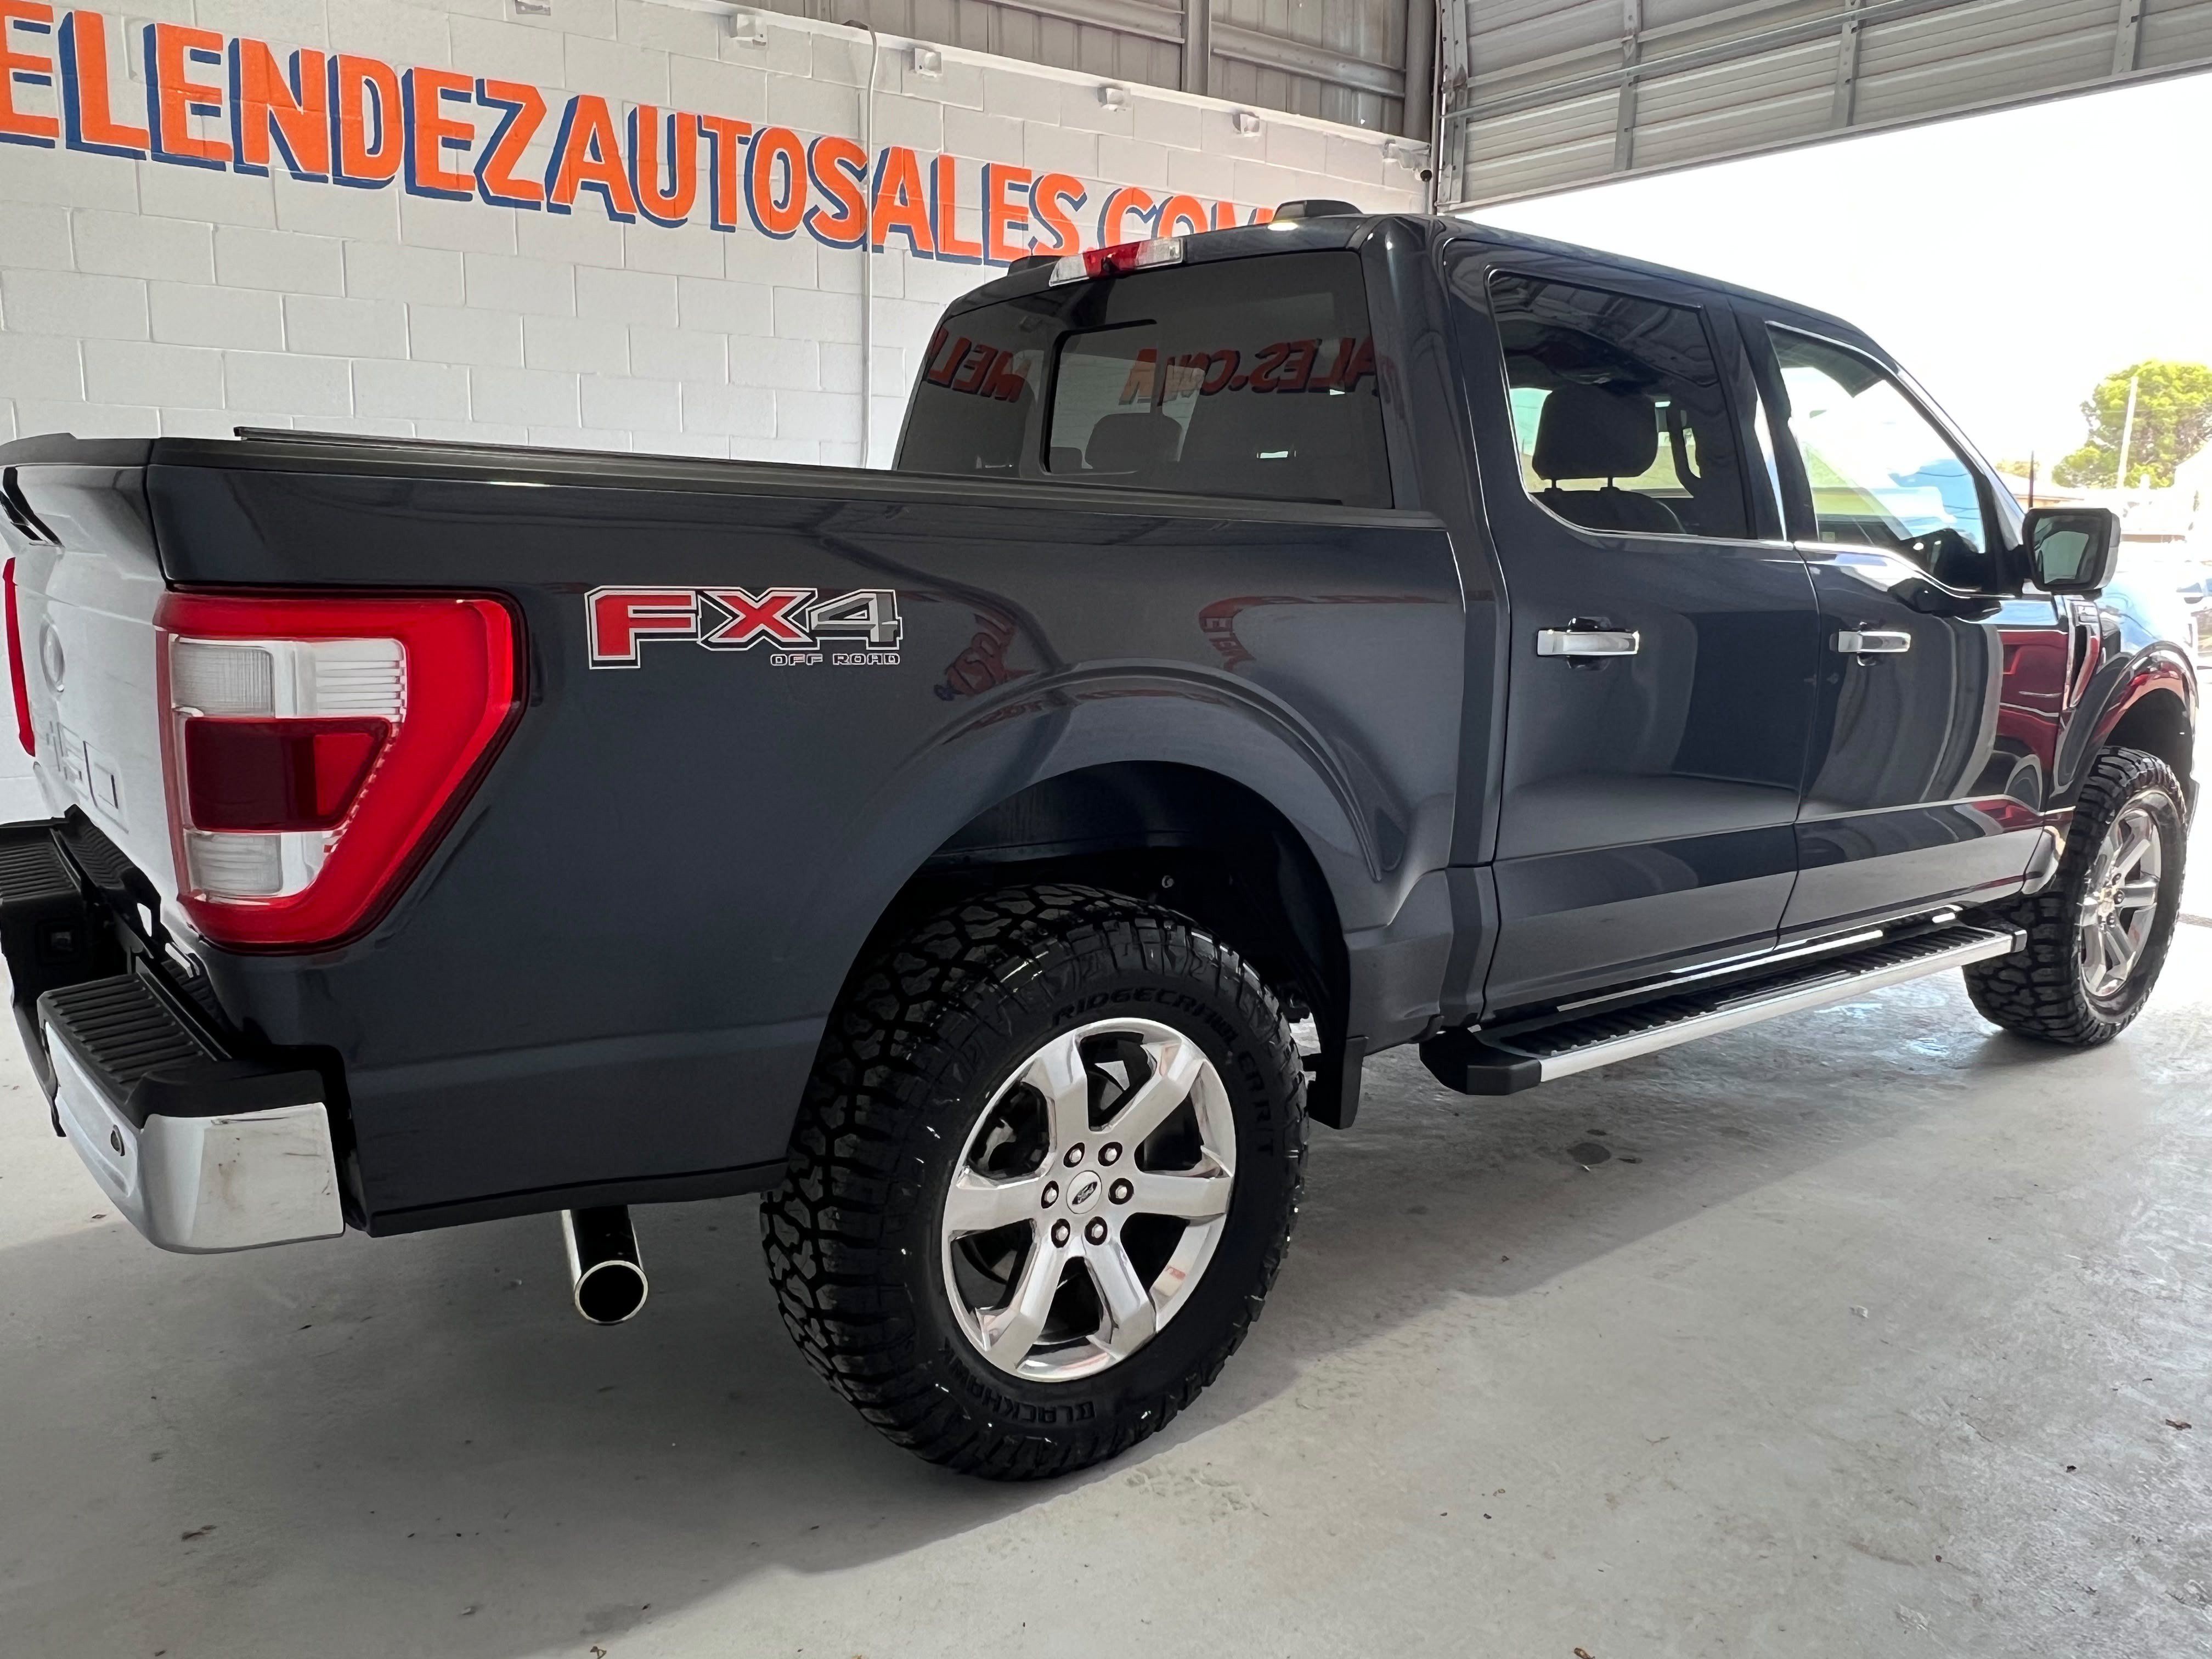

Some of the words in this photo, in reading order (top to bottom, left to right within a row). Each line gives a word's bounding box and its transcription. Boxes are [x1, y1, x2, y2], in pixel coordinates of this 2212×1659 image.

[584, 585, 903, 669] FX4
[770, 653, 823, 666] OFF
[832, 653, 900, 666] ROAD
